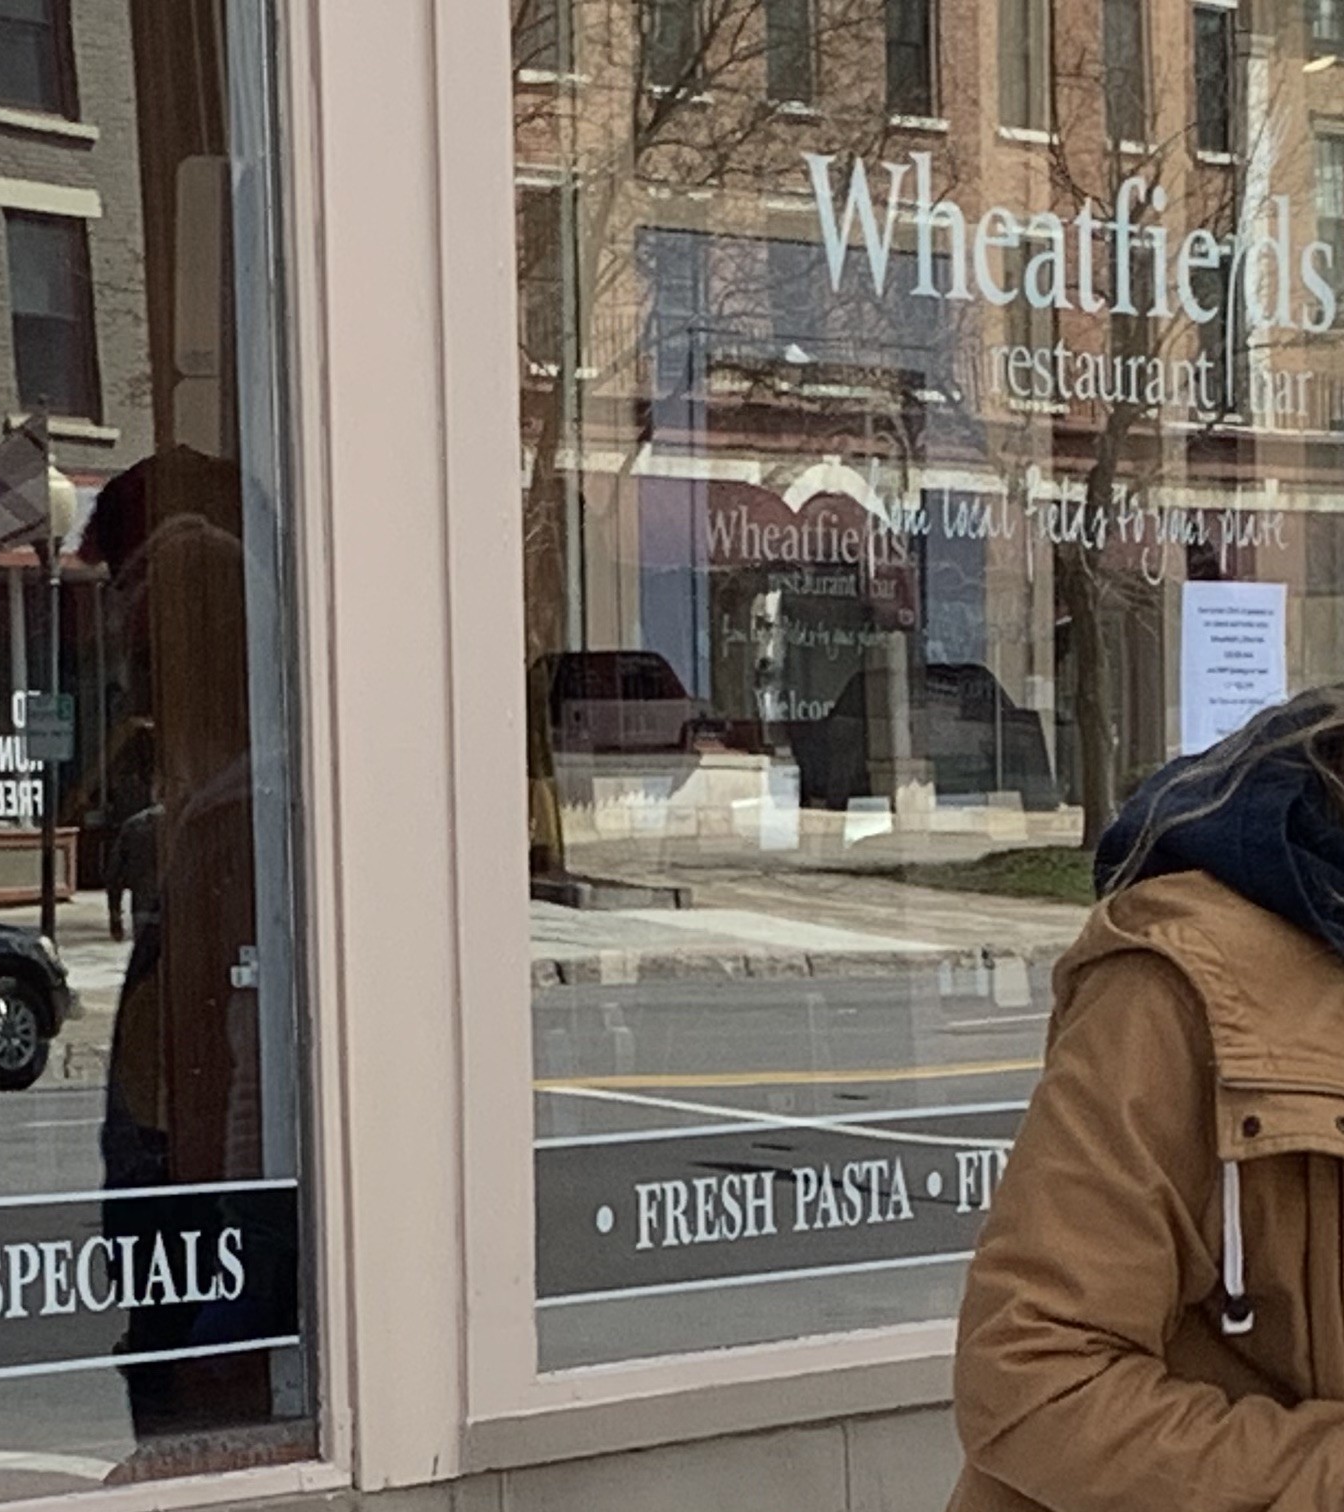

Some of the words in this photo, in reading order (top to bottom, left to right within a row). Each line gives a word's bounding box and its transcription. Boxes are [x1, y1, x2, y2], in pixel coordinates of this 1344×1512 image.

[990, 336, 1215, 410] restaurant
[1250, 344, 1314, 416] bar
[943, 488, 1017, 542] local
[634, 1169, 778, 1250] FRESH
[791, 1156, 915, 1232] PASTA
